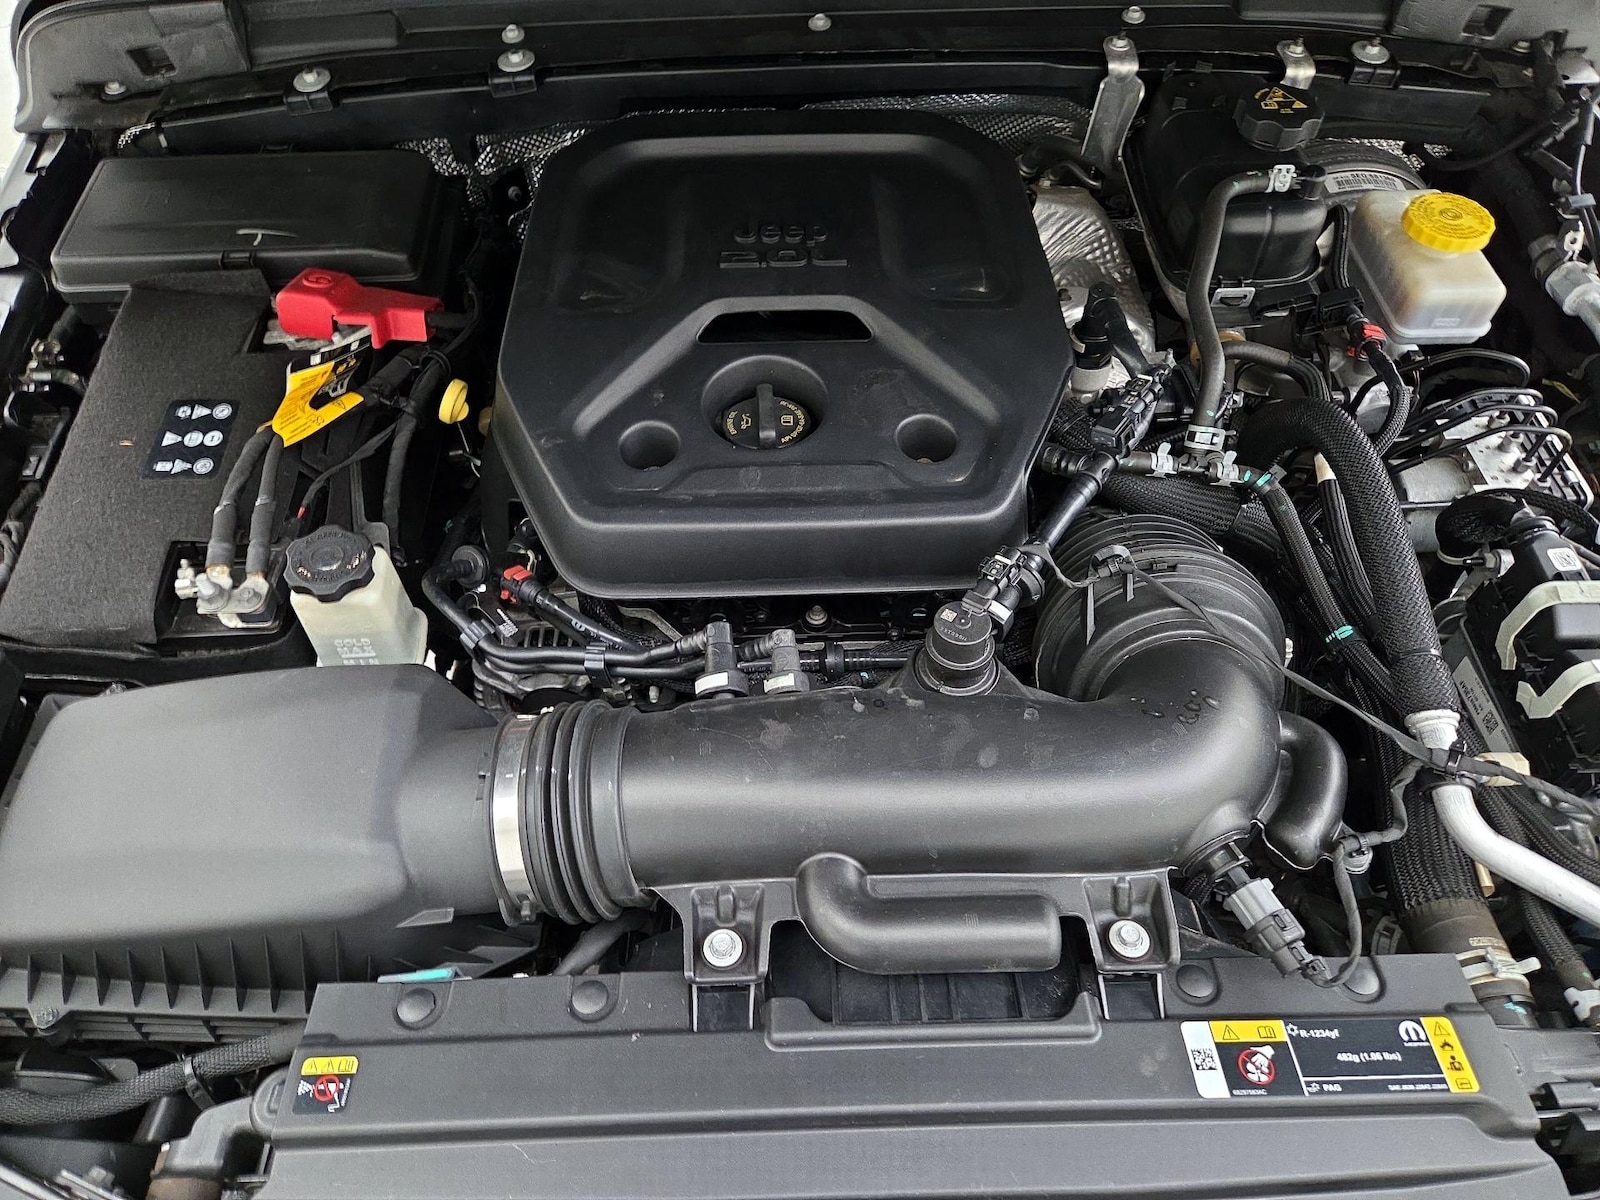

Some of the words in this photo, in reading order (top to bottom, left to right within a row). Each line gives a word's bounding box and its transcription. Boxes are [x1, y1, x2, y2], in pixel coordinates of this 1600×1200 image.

[734, 225, 828, 247] Jeep
[719, 251, 848, 268] 2.0L
[334, 638, 371, 647] COLD
[1300, 1029, 1340, 1039] R-1234yf
[1323, 1084, 1343, 1092] PAG
